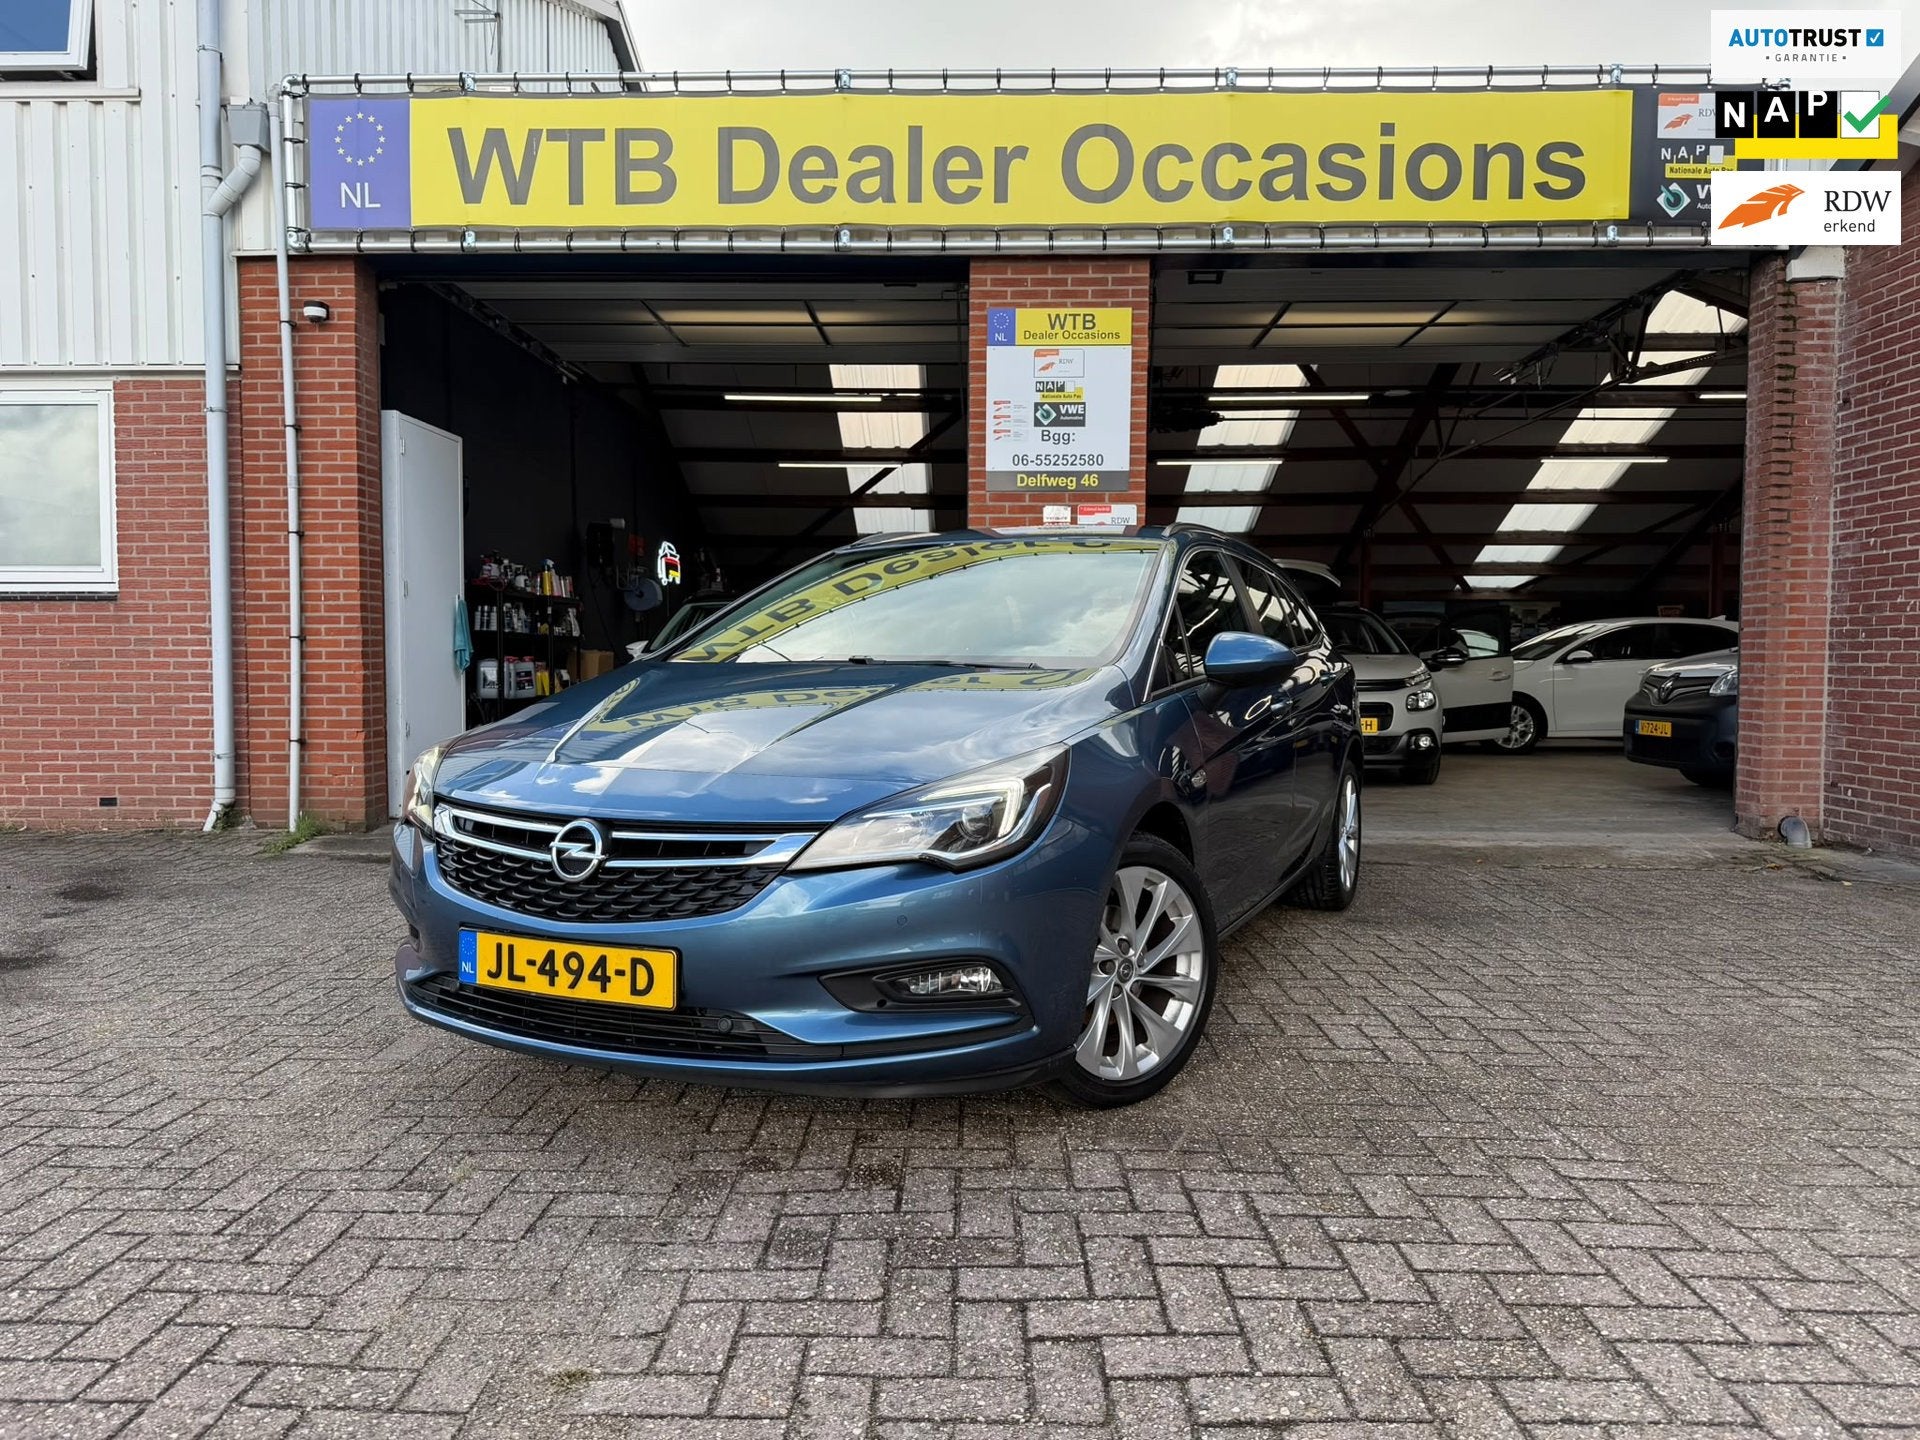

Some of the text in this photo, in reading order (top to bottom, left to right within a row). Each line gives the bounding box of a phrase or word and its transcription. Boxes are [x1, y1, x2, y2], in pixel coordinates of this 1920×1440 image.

[446, 122, 1586, 206] WTB Dealer Occasions
[340, 182, 381, 208] NL
[1047, 313, 1097, 330] WTB
[994, 333, 1008, 342] NL
[1023, 330, 1121, 340] Dealer Occasions
[1059, 404, 1085, 415] VWE
[1040, 429, 1076, 445] Bgg:
[1012, 454, 1104, 467] 06-55252580
[1016, 473, 1099, 489] Delfweg 46
[461, 961, 475, 974] NL
[486, 942, 655, 997] JL-494-D
